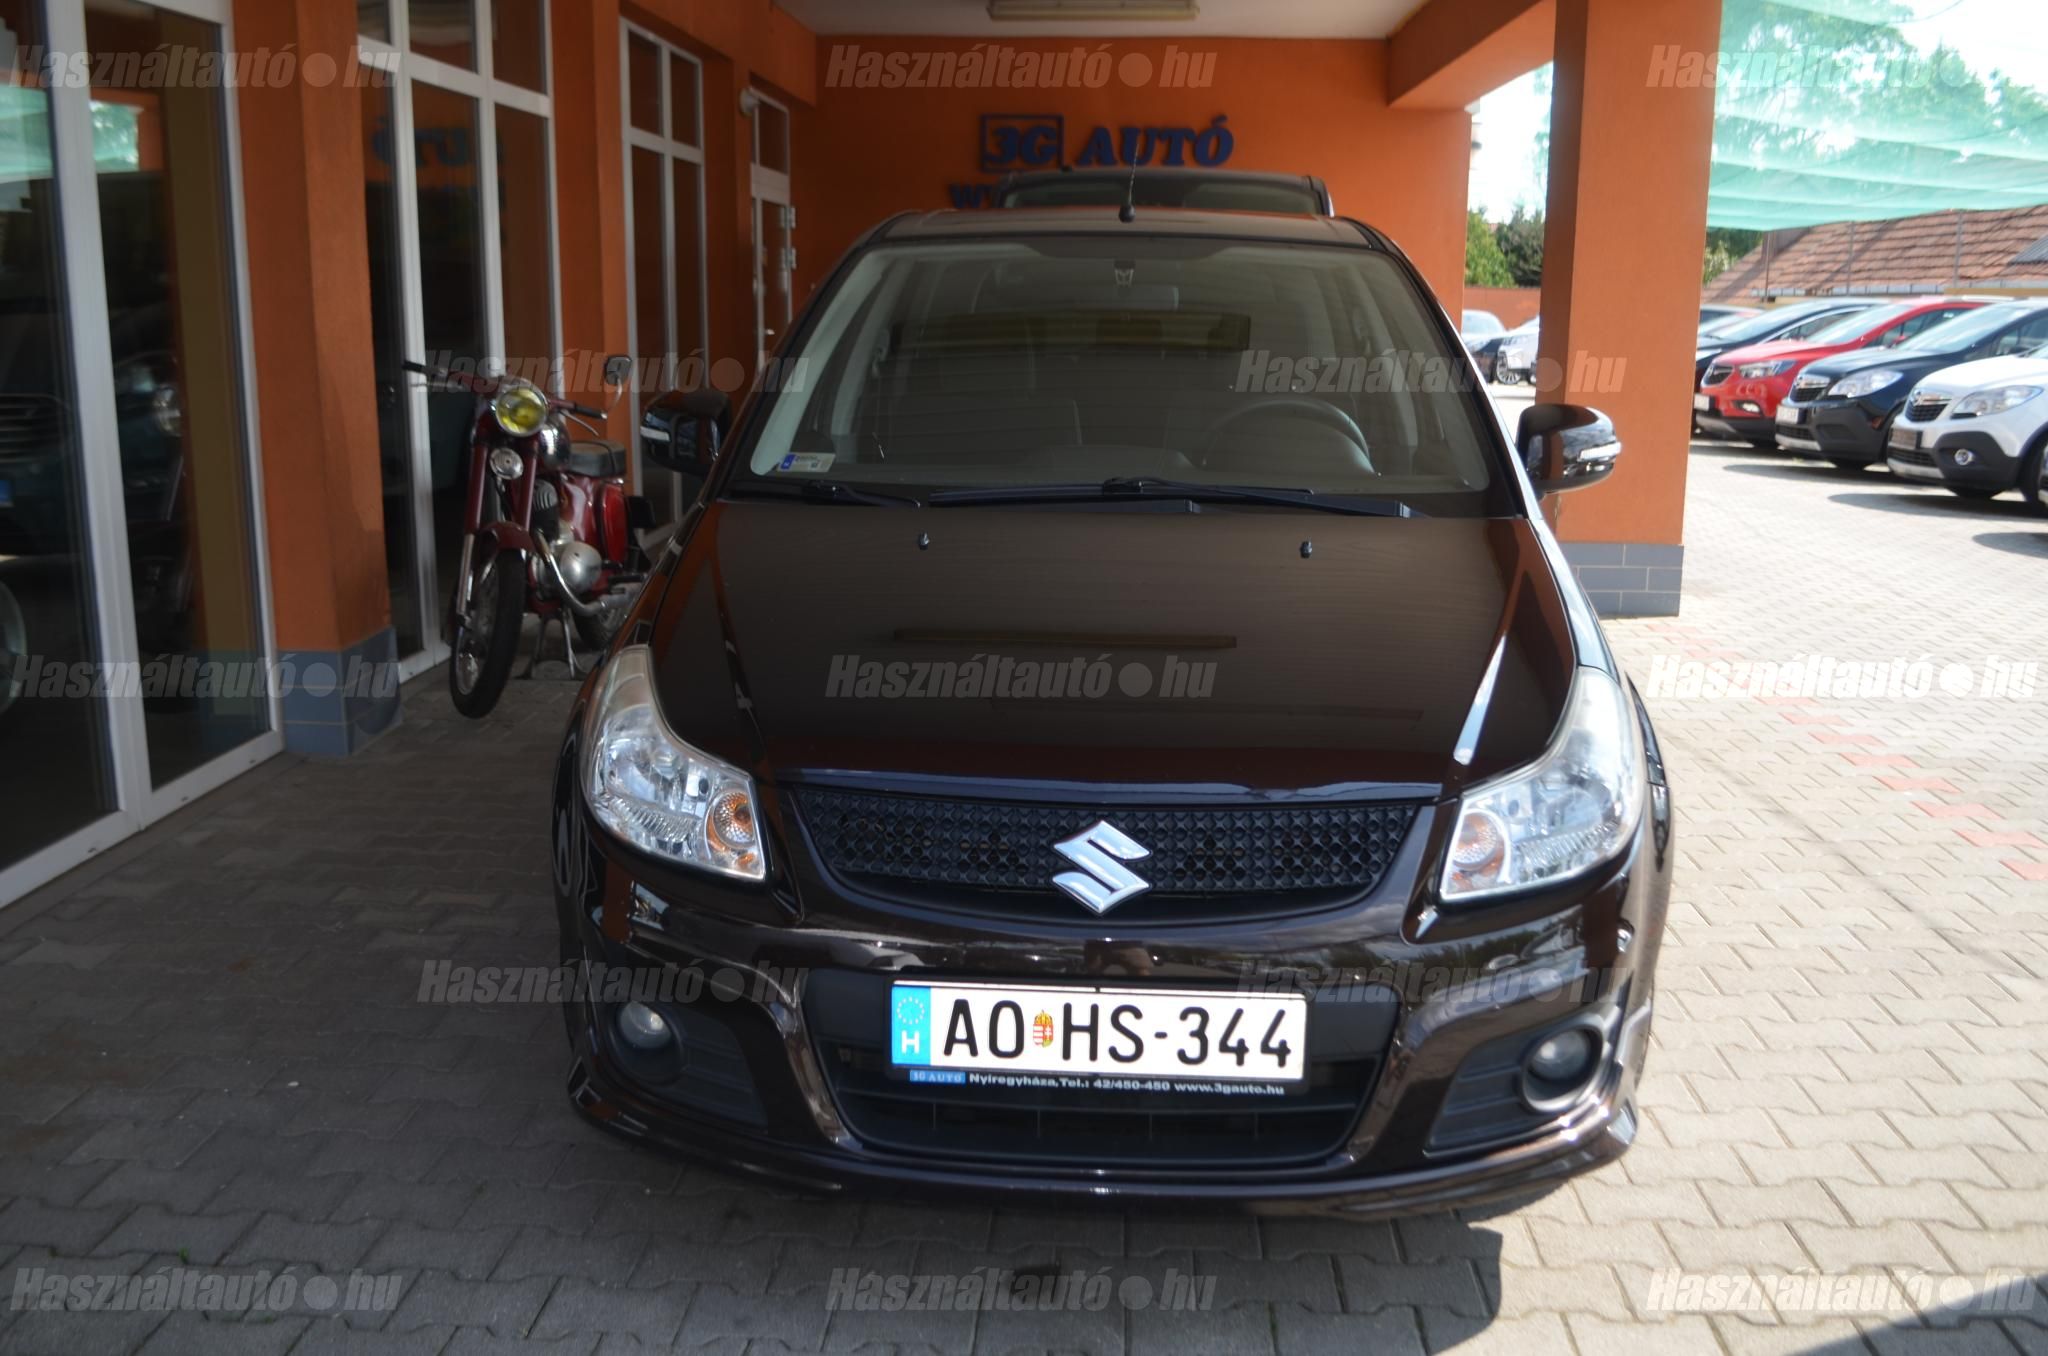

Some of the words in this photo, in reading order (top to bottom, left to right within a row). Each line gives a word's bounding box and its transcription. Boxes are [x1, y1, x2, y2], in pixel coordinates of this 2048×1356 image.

[983, 126, 1058, 166] 3G
[1076, 114, 1234, 167] AUTÓ
[901, 1030, 920, 1054] H
[1061, 1002, 1291, 1068] HS-344
